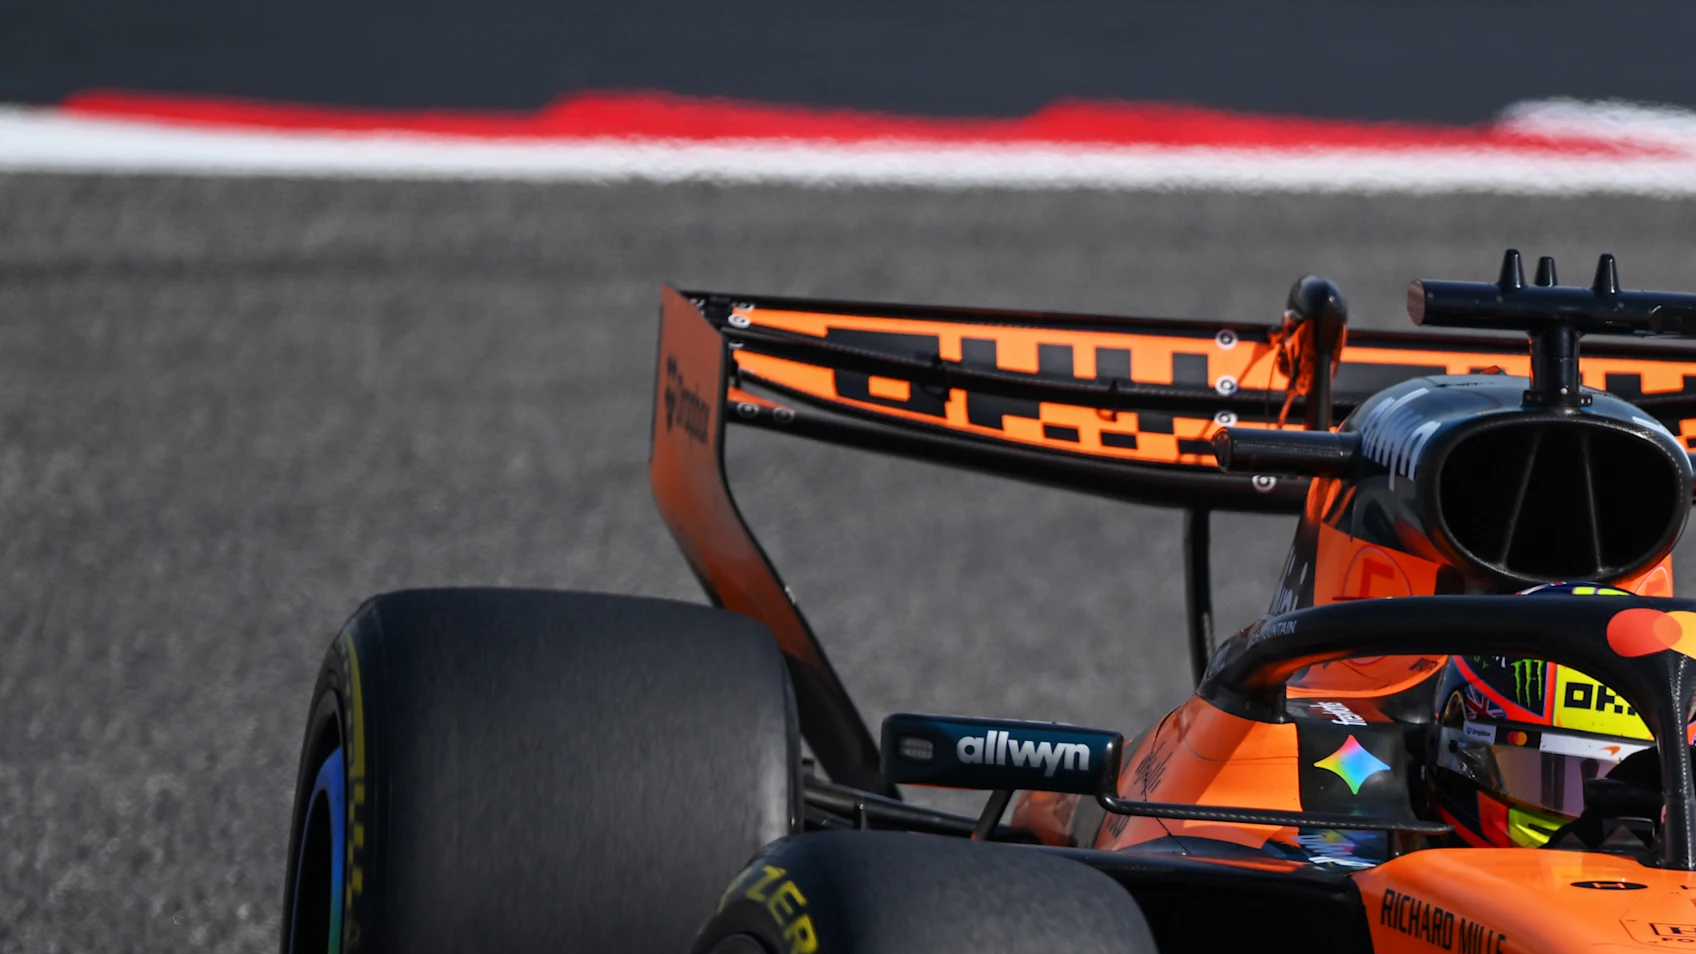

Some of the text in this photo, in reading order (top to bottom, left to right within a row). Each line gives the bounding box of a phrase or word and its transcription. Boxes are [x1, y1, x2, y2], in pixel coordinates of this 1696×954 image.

[1564, 681, 1636, 716] OK
[956, 729, 1090, 777] allwyn
[1380, 888, 1455, 952] RICHARD
